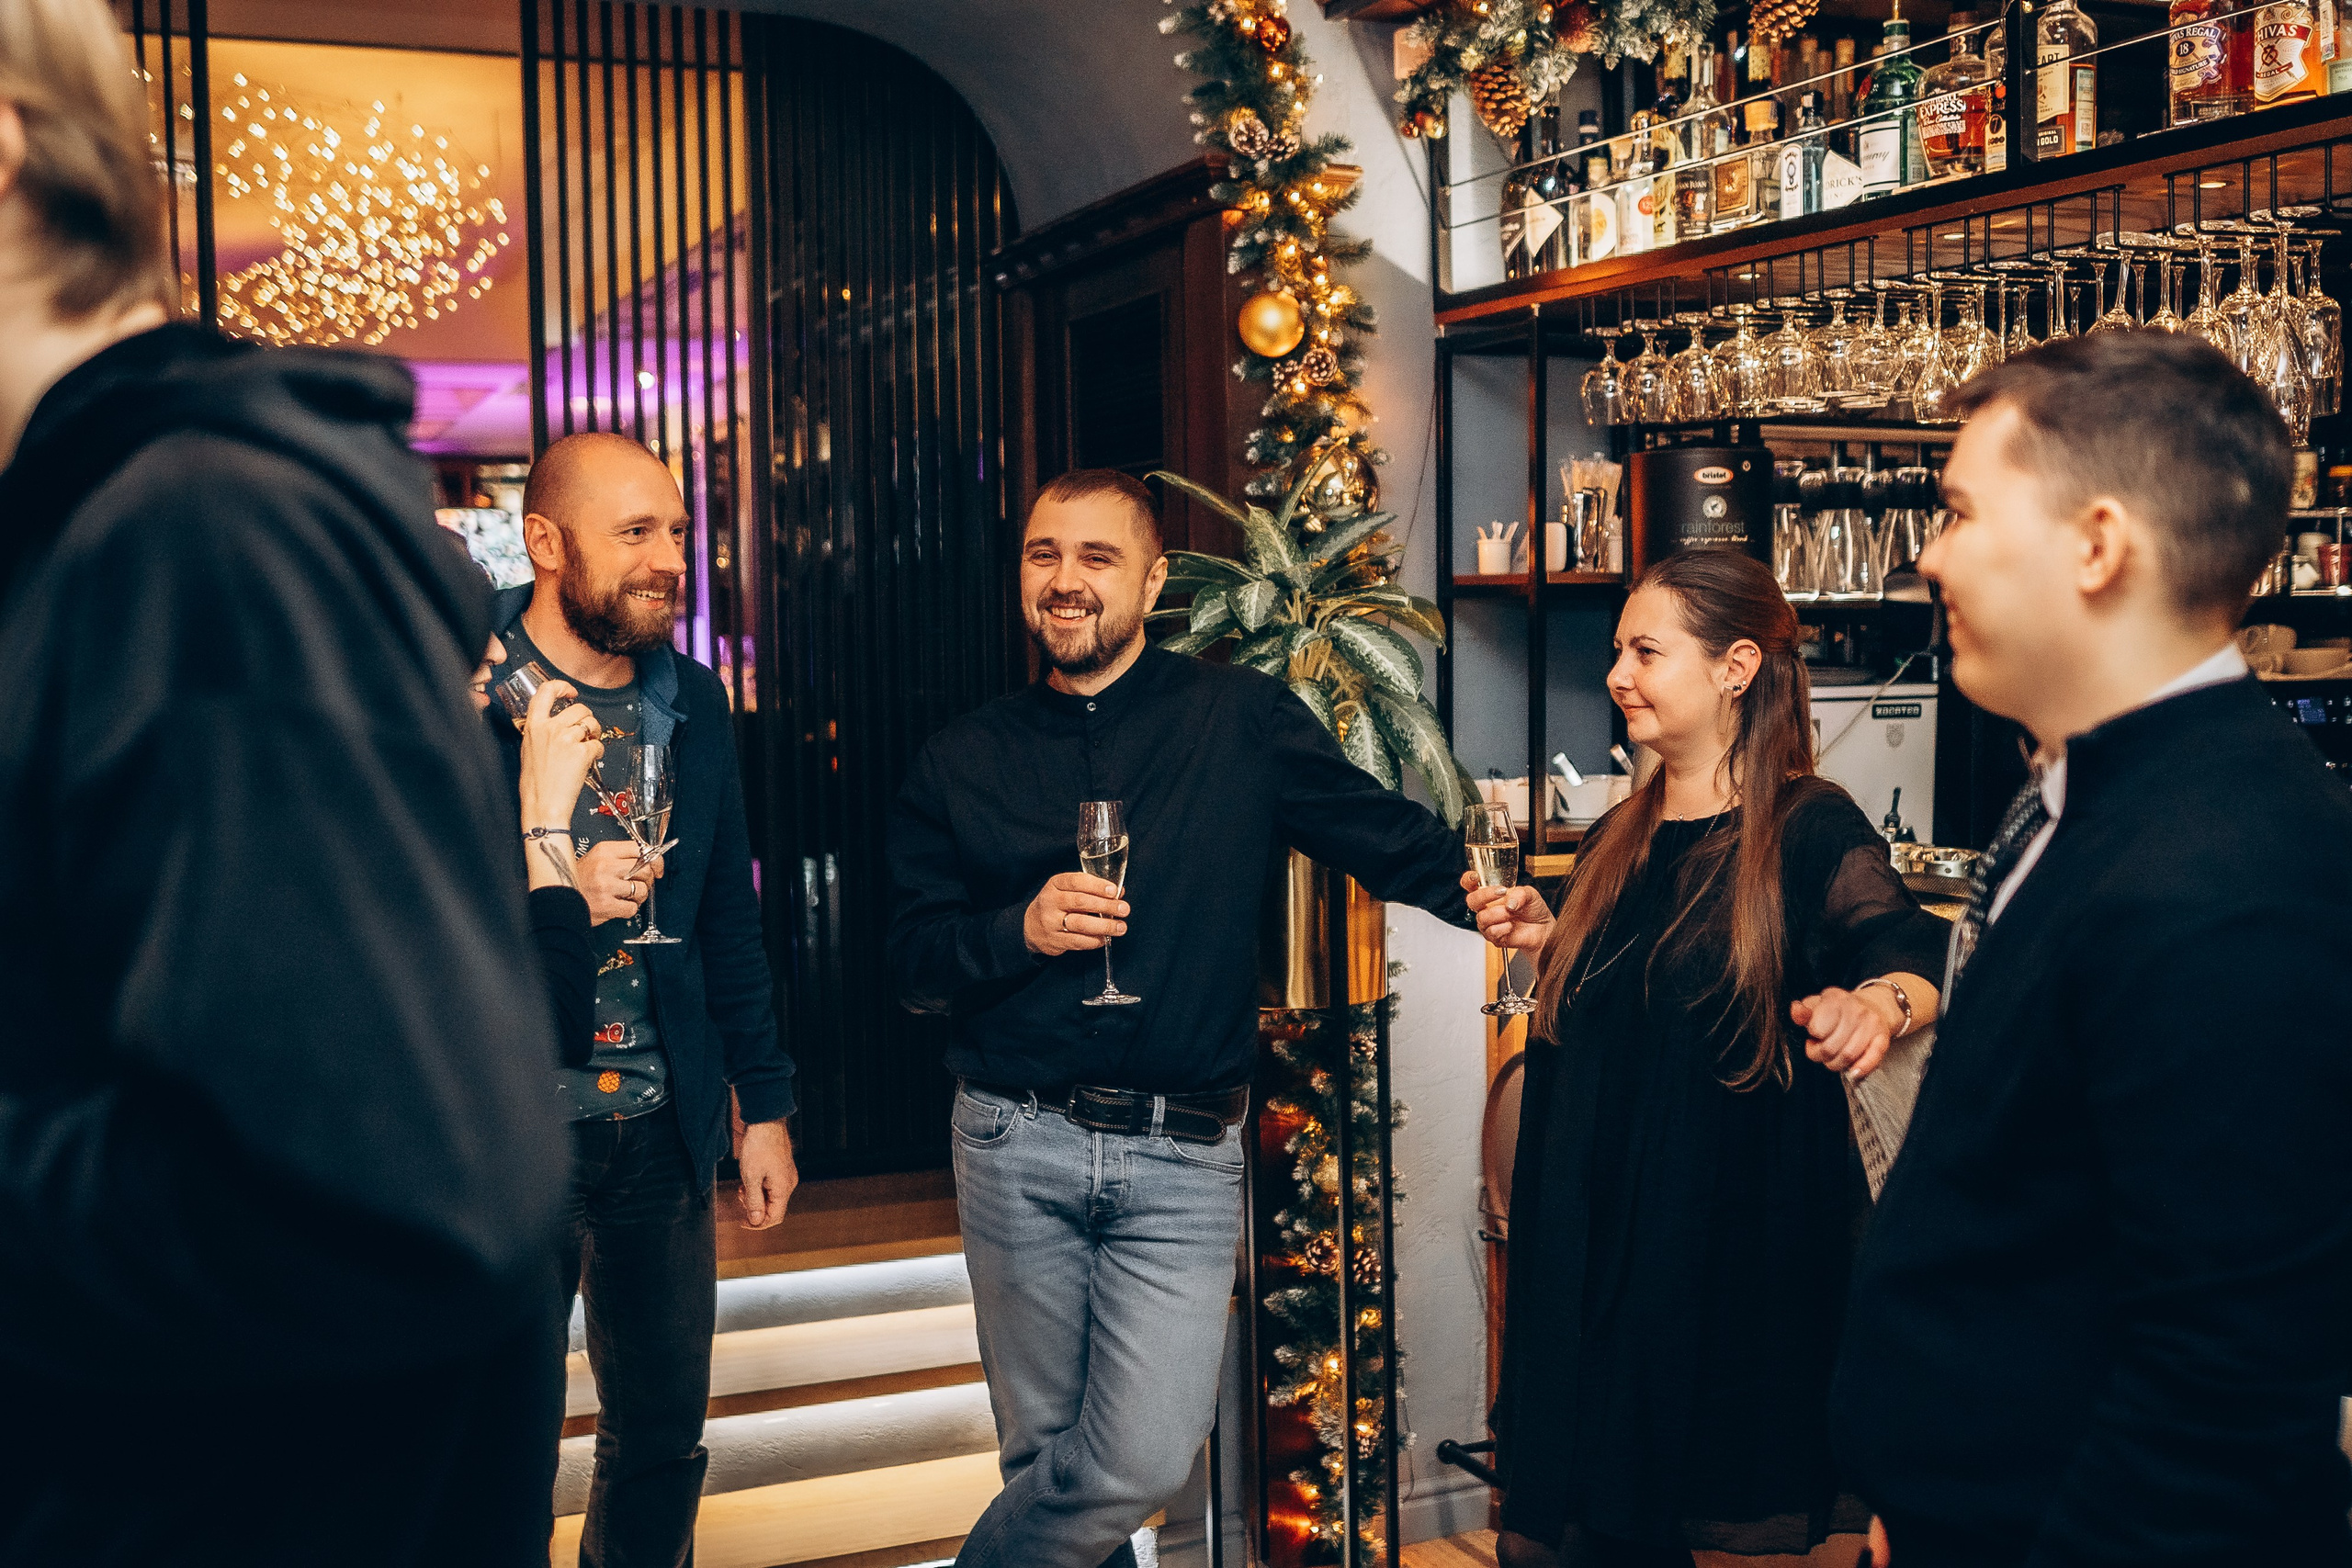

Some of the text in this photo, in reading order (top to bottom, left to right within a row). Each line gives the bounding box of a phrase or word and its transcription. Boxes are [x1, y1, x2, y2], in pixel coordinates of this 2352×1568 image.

[2186, 27, 2215, 38] REGAL
[2178, 42, 2189, 55] 18
[1919, 99, 1964, 118] EXPRESS
[1681, 520, 1745, 534] rainforest
